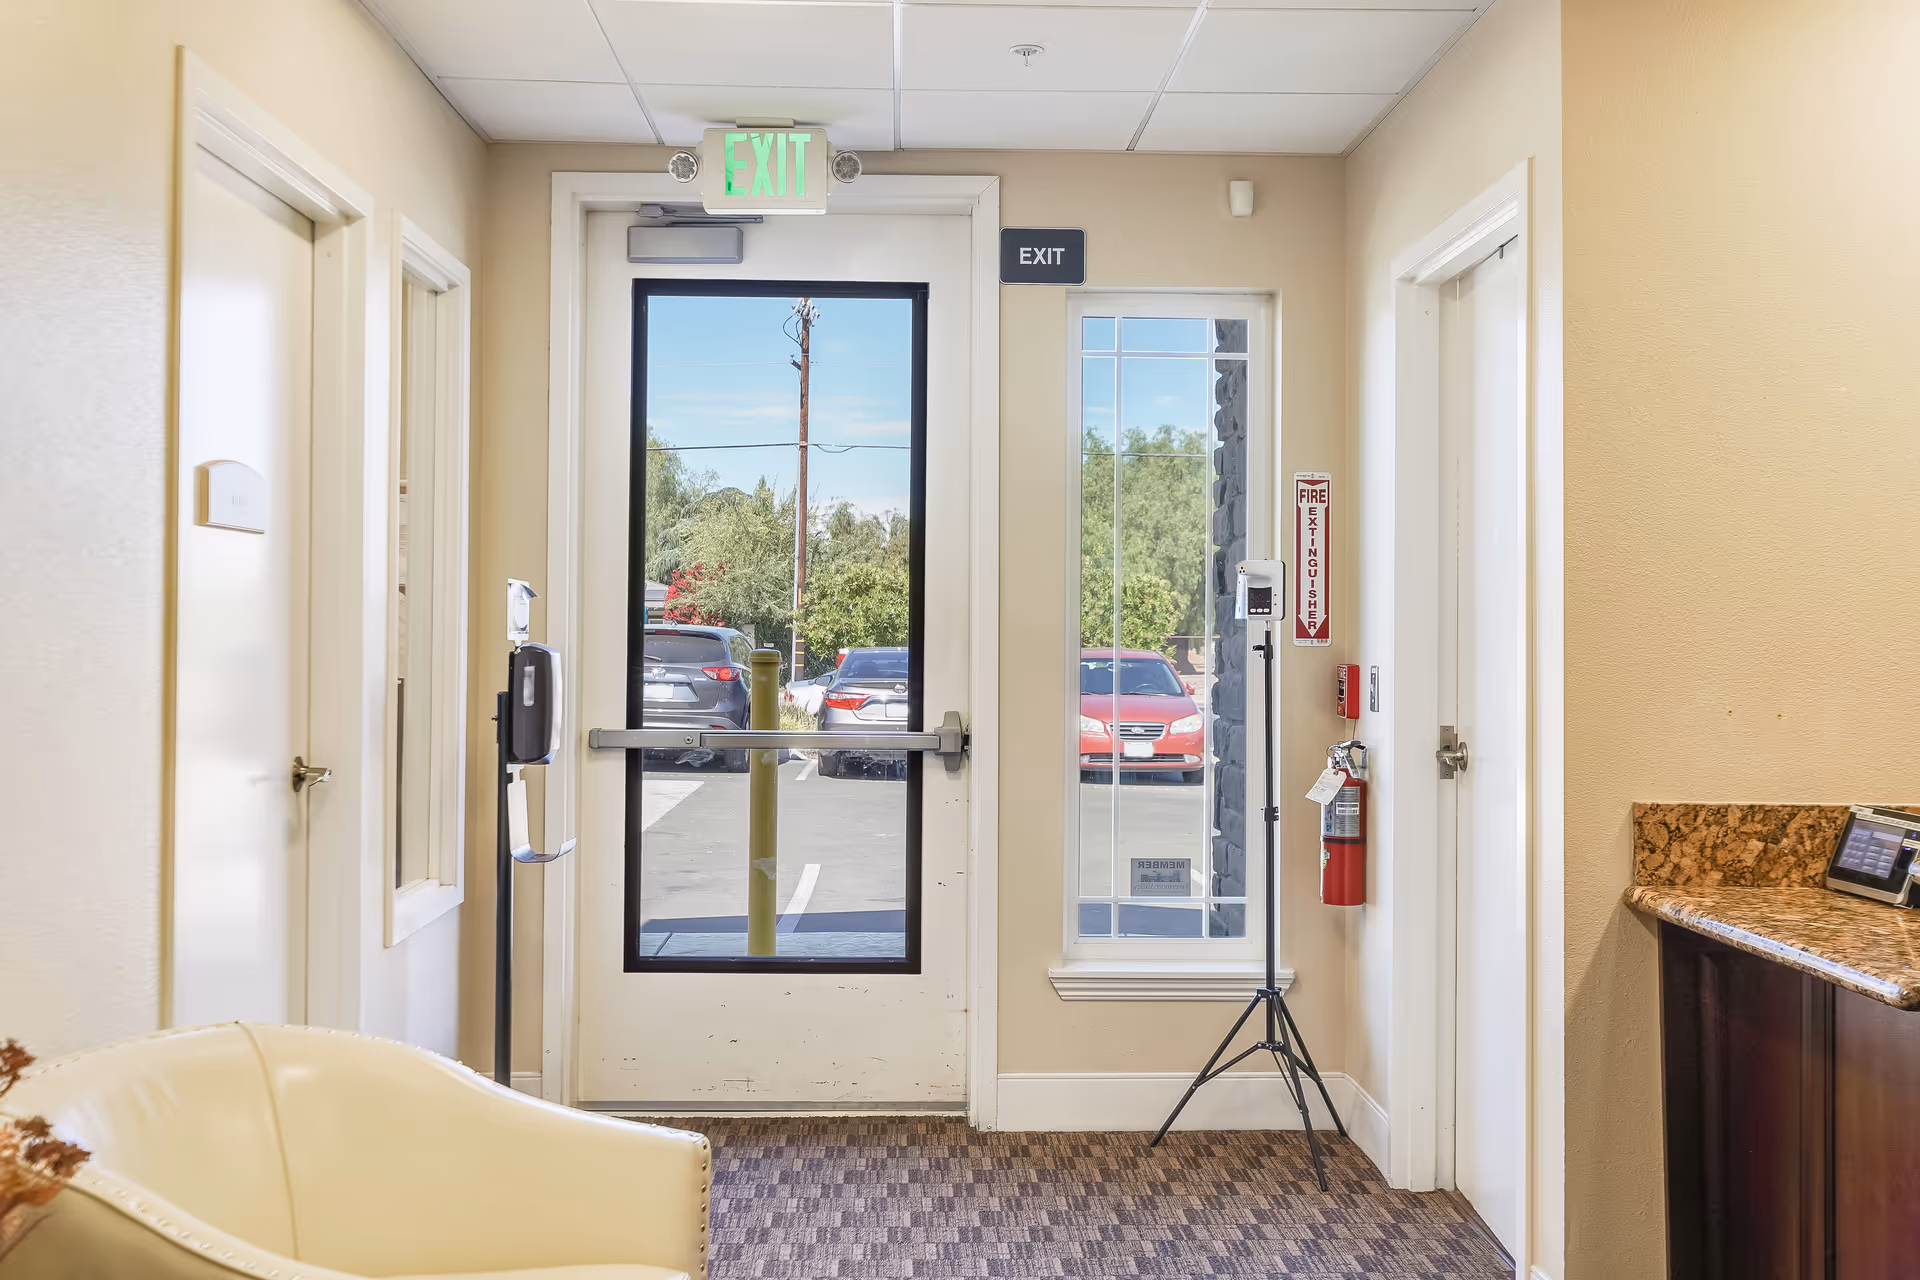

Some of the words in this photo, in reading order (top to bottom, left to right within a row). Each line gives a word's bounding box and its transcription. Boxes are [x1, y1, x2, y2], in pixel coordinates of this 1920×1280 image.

[724, 132, 812, 197] EXIT
[1019, 247, 1065, 265] EXIT
[1299, 488, 1327, 504] FIRE
[1307, 506, 1318, 630] EXTINGUISHER
